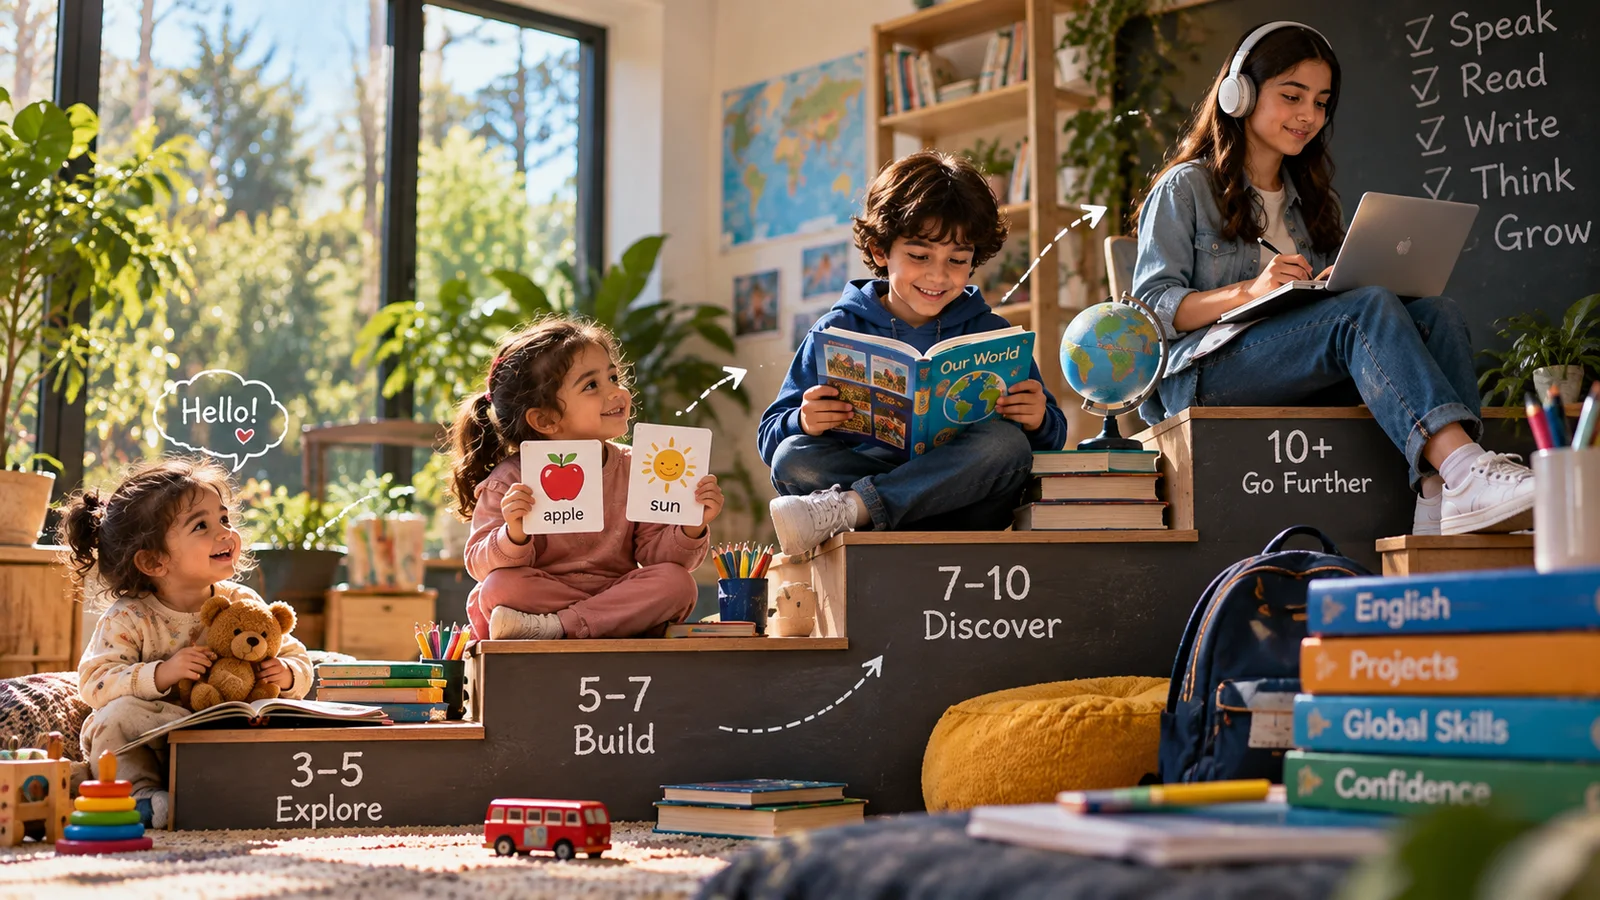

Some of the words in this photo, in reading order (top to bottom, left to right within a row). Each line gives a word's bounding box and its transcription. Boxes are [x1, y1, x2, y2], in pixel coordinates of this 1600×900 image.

[1450, 0, 1558, 55] Speak
[1460, 52, 1548, 98] Read
[1464, 109, 1560, 147] Write
[1470, 157, 1575, 199] Think
[1494, 213, 1592, 251] Grow
[940, 357, 970, 375] Our
[973, 346, 1020, 366] World
[1267, 429, 1333, 464] 10+
[1242, 471, 1274, 494] Go
[1283, 471, 1373, 494] Further
[543, 507, 584, 524] apple
[650, 499, 681, 513] sun
[923, 610, 1062, 641] Discover
[1355, 588, 1450, 628] English
[1350, 650, 1459, 687] Projects
[574, 722, 656, 756] Build
[1343, 709, 1428, 742] Global
[1435, 710, 1509, 744] Skills
[1335, 767, 1491, 806] Confidence
[276, 793, 383, 829] Explore
